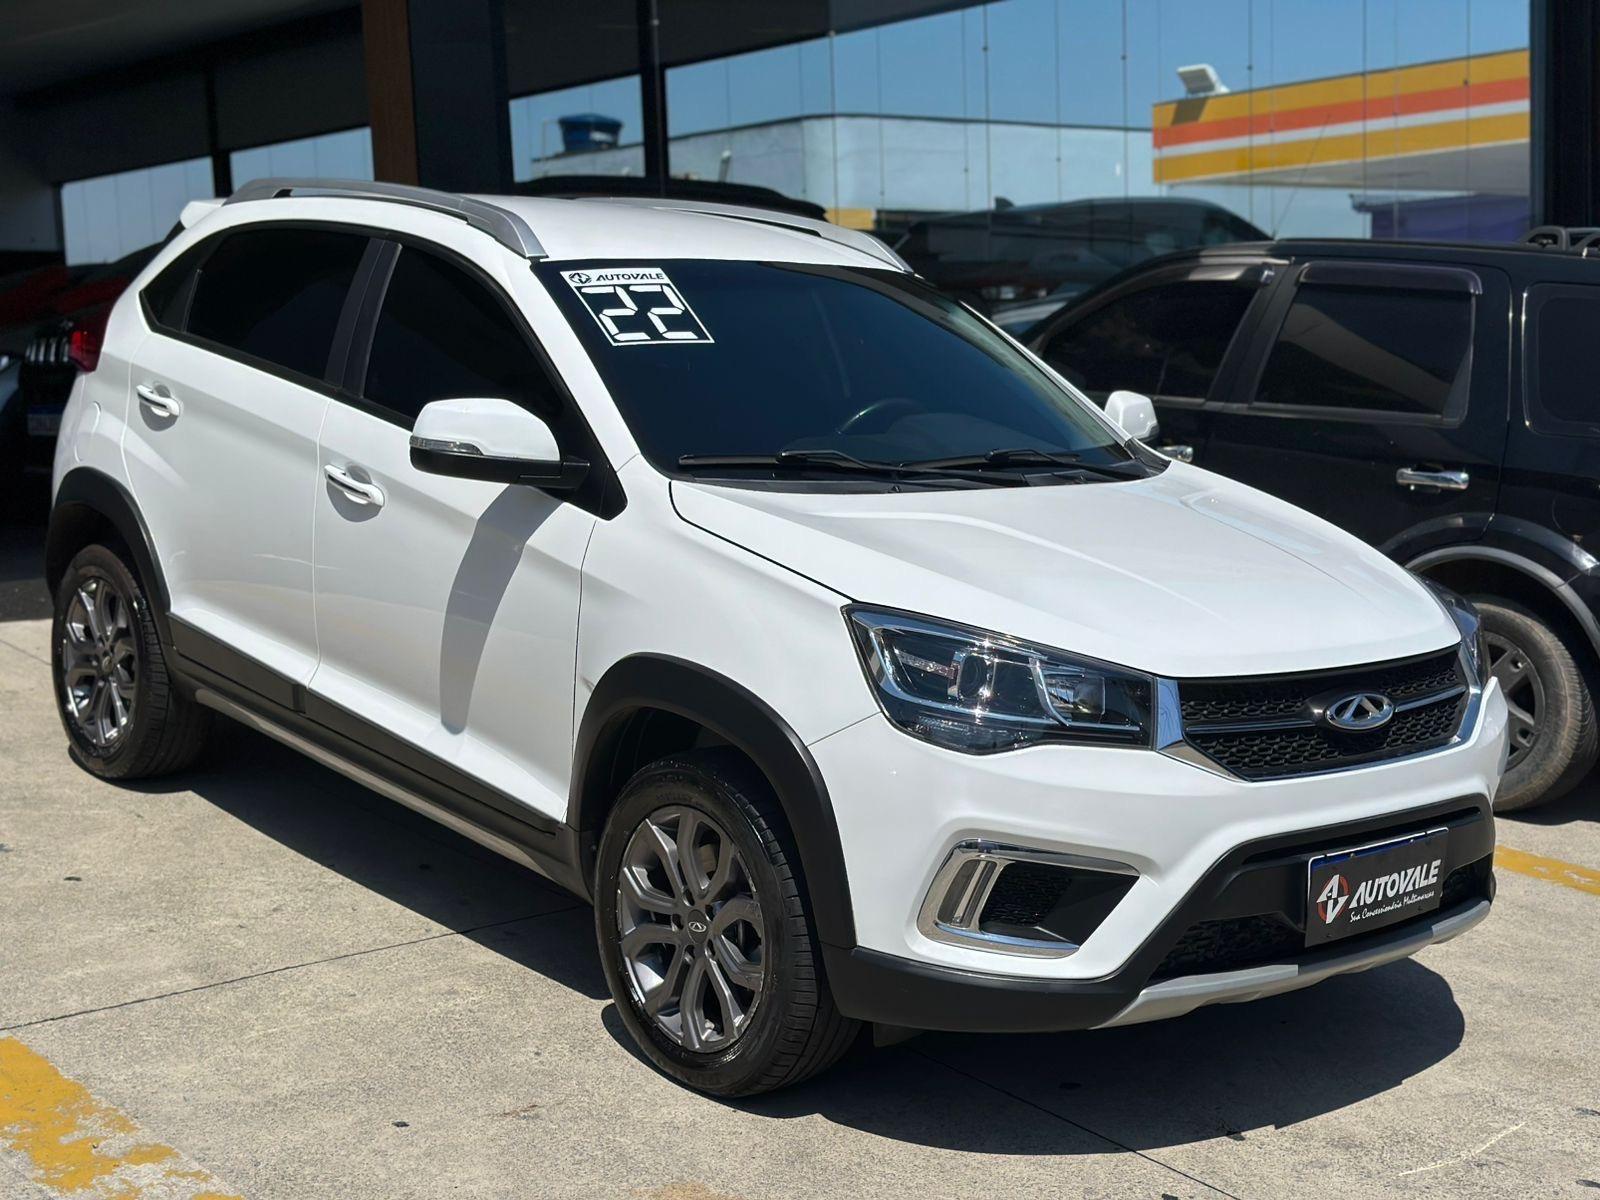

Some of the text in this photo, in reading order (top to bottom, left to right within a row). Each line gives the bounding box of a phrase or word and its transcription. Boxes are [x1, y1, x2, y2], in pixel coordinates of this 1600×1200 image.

[596, 273, 664, 282] AUTOVALE
[581, 285, 699, 341] 22
[1348, 859, 1442, 909] AUTOVALE
